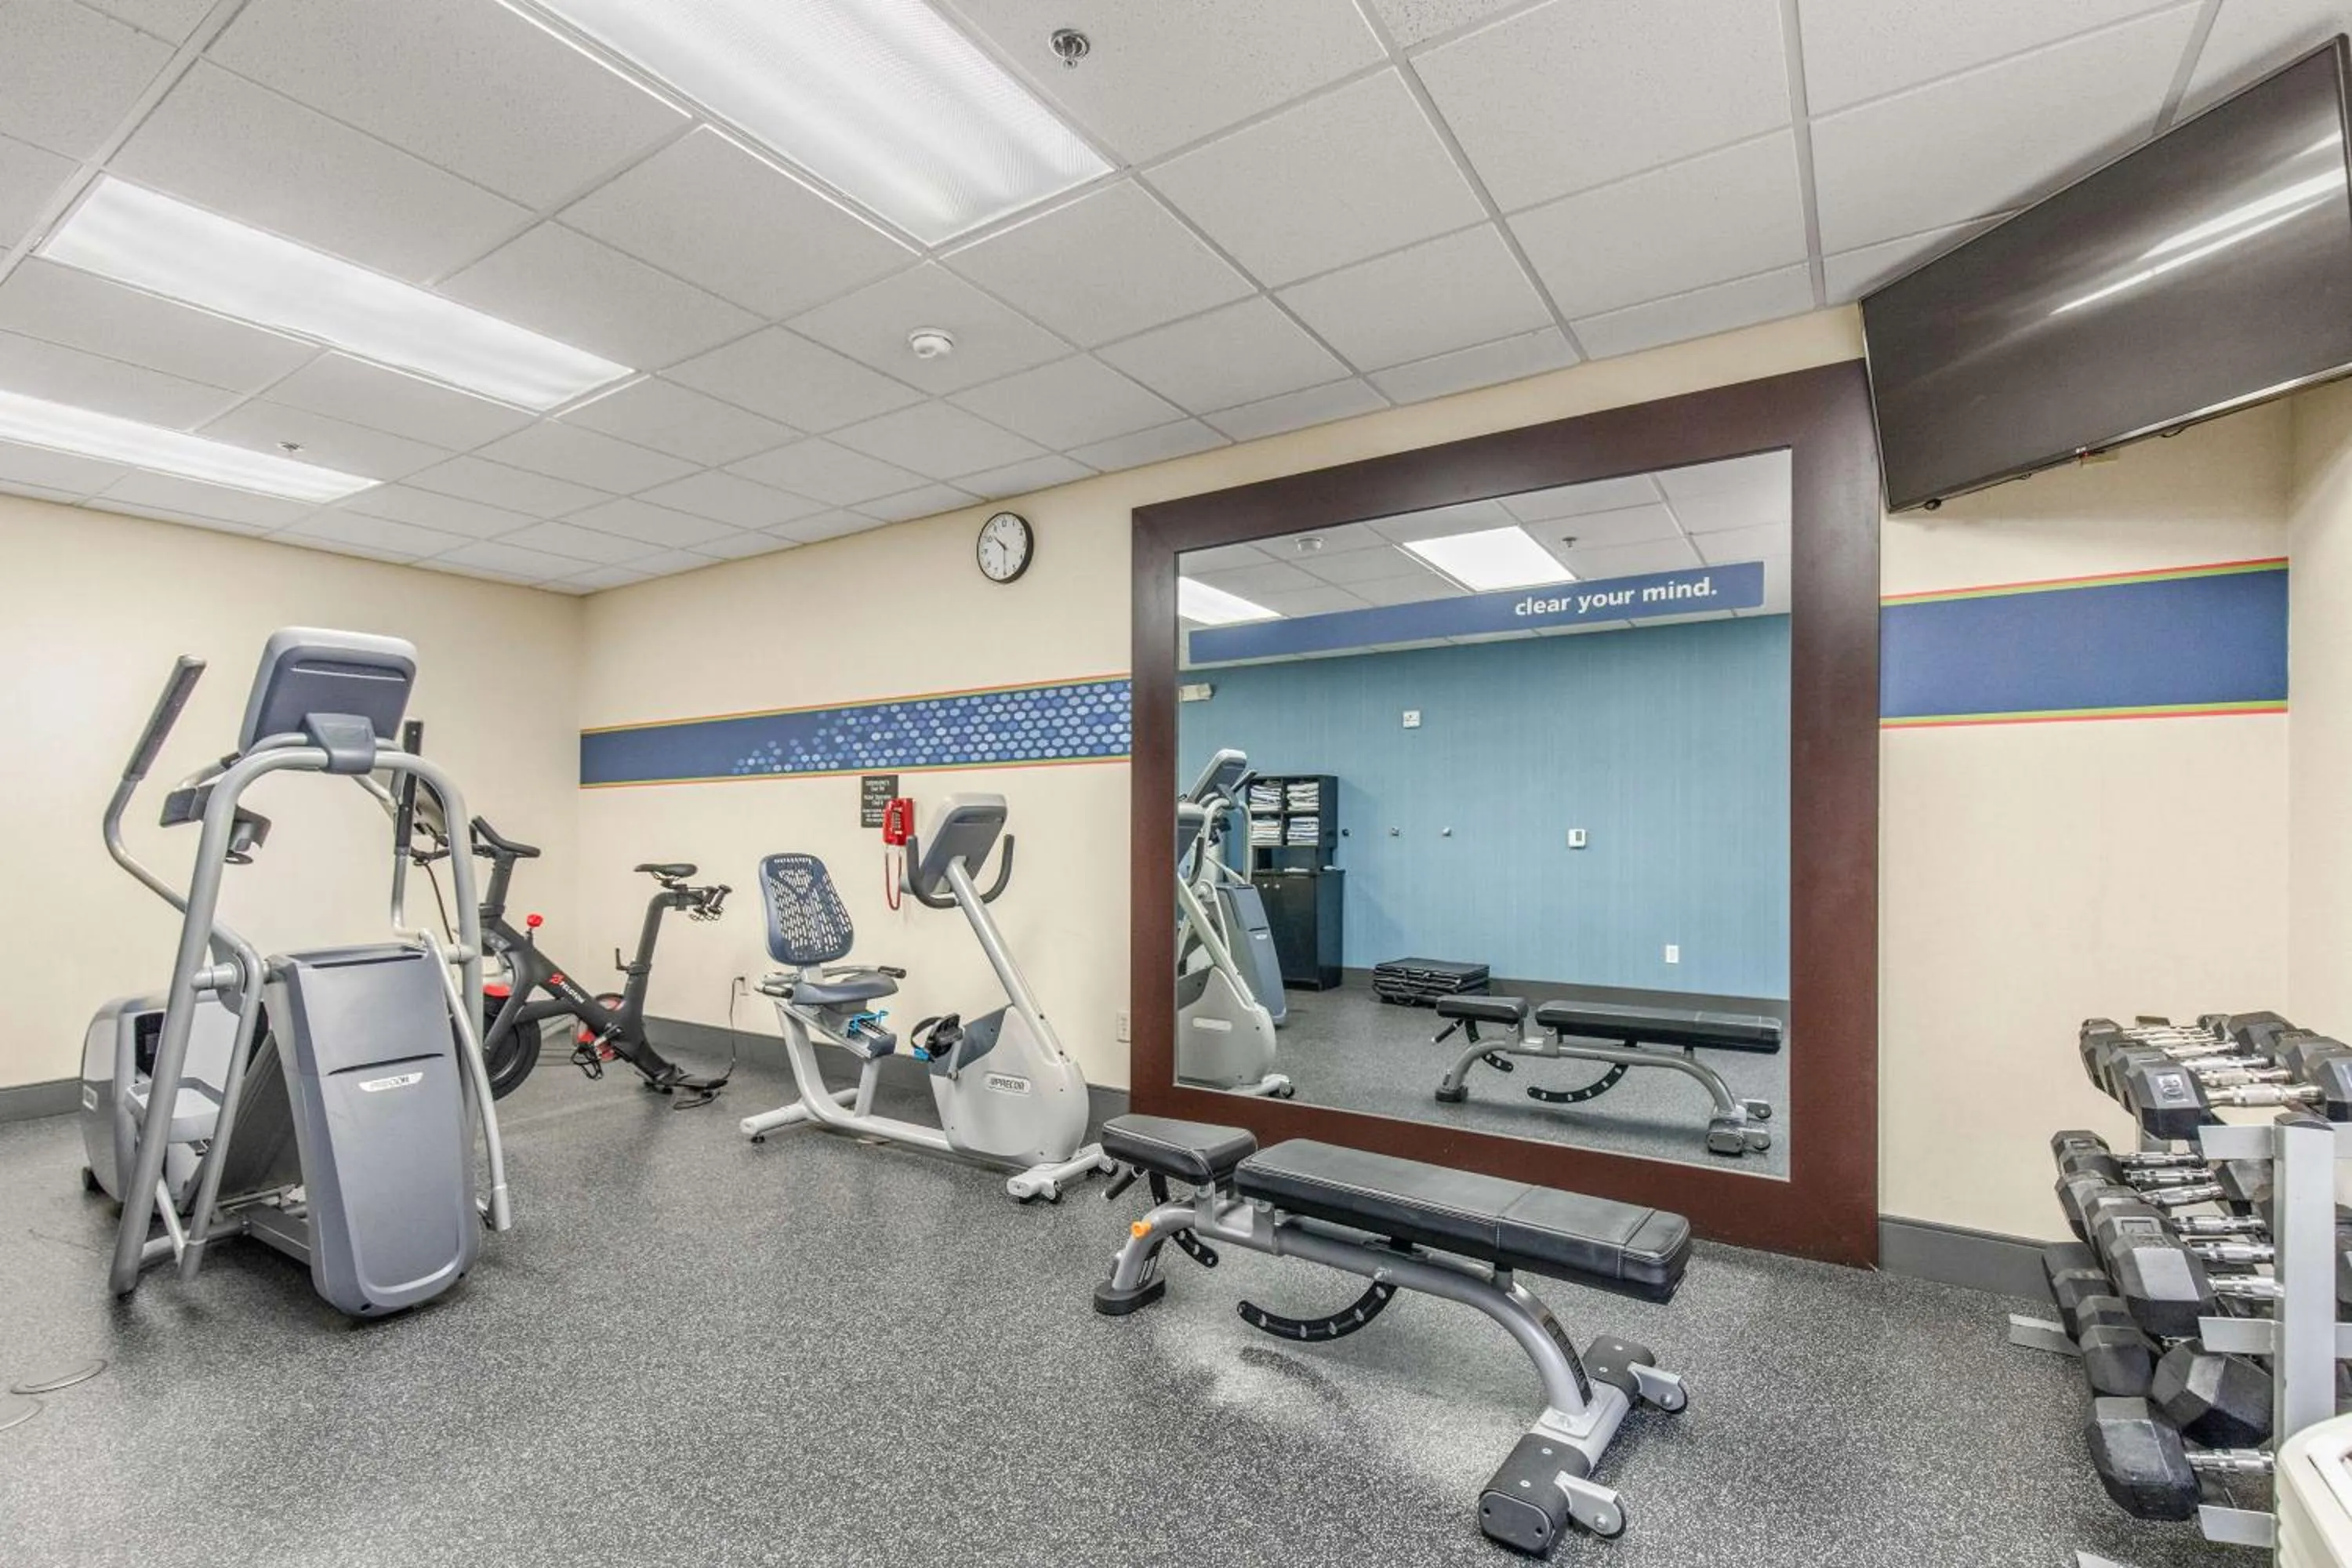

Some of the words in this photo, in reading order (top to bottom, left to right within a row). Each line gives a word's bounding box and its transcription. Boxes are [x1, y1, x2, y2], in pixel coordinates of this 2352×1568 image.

[1515, 597, 1571, 616] clear
[1577, 589, 1635, 614] your
[1642, 576, 1718, 602] mind.
